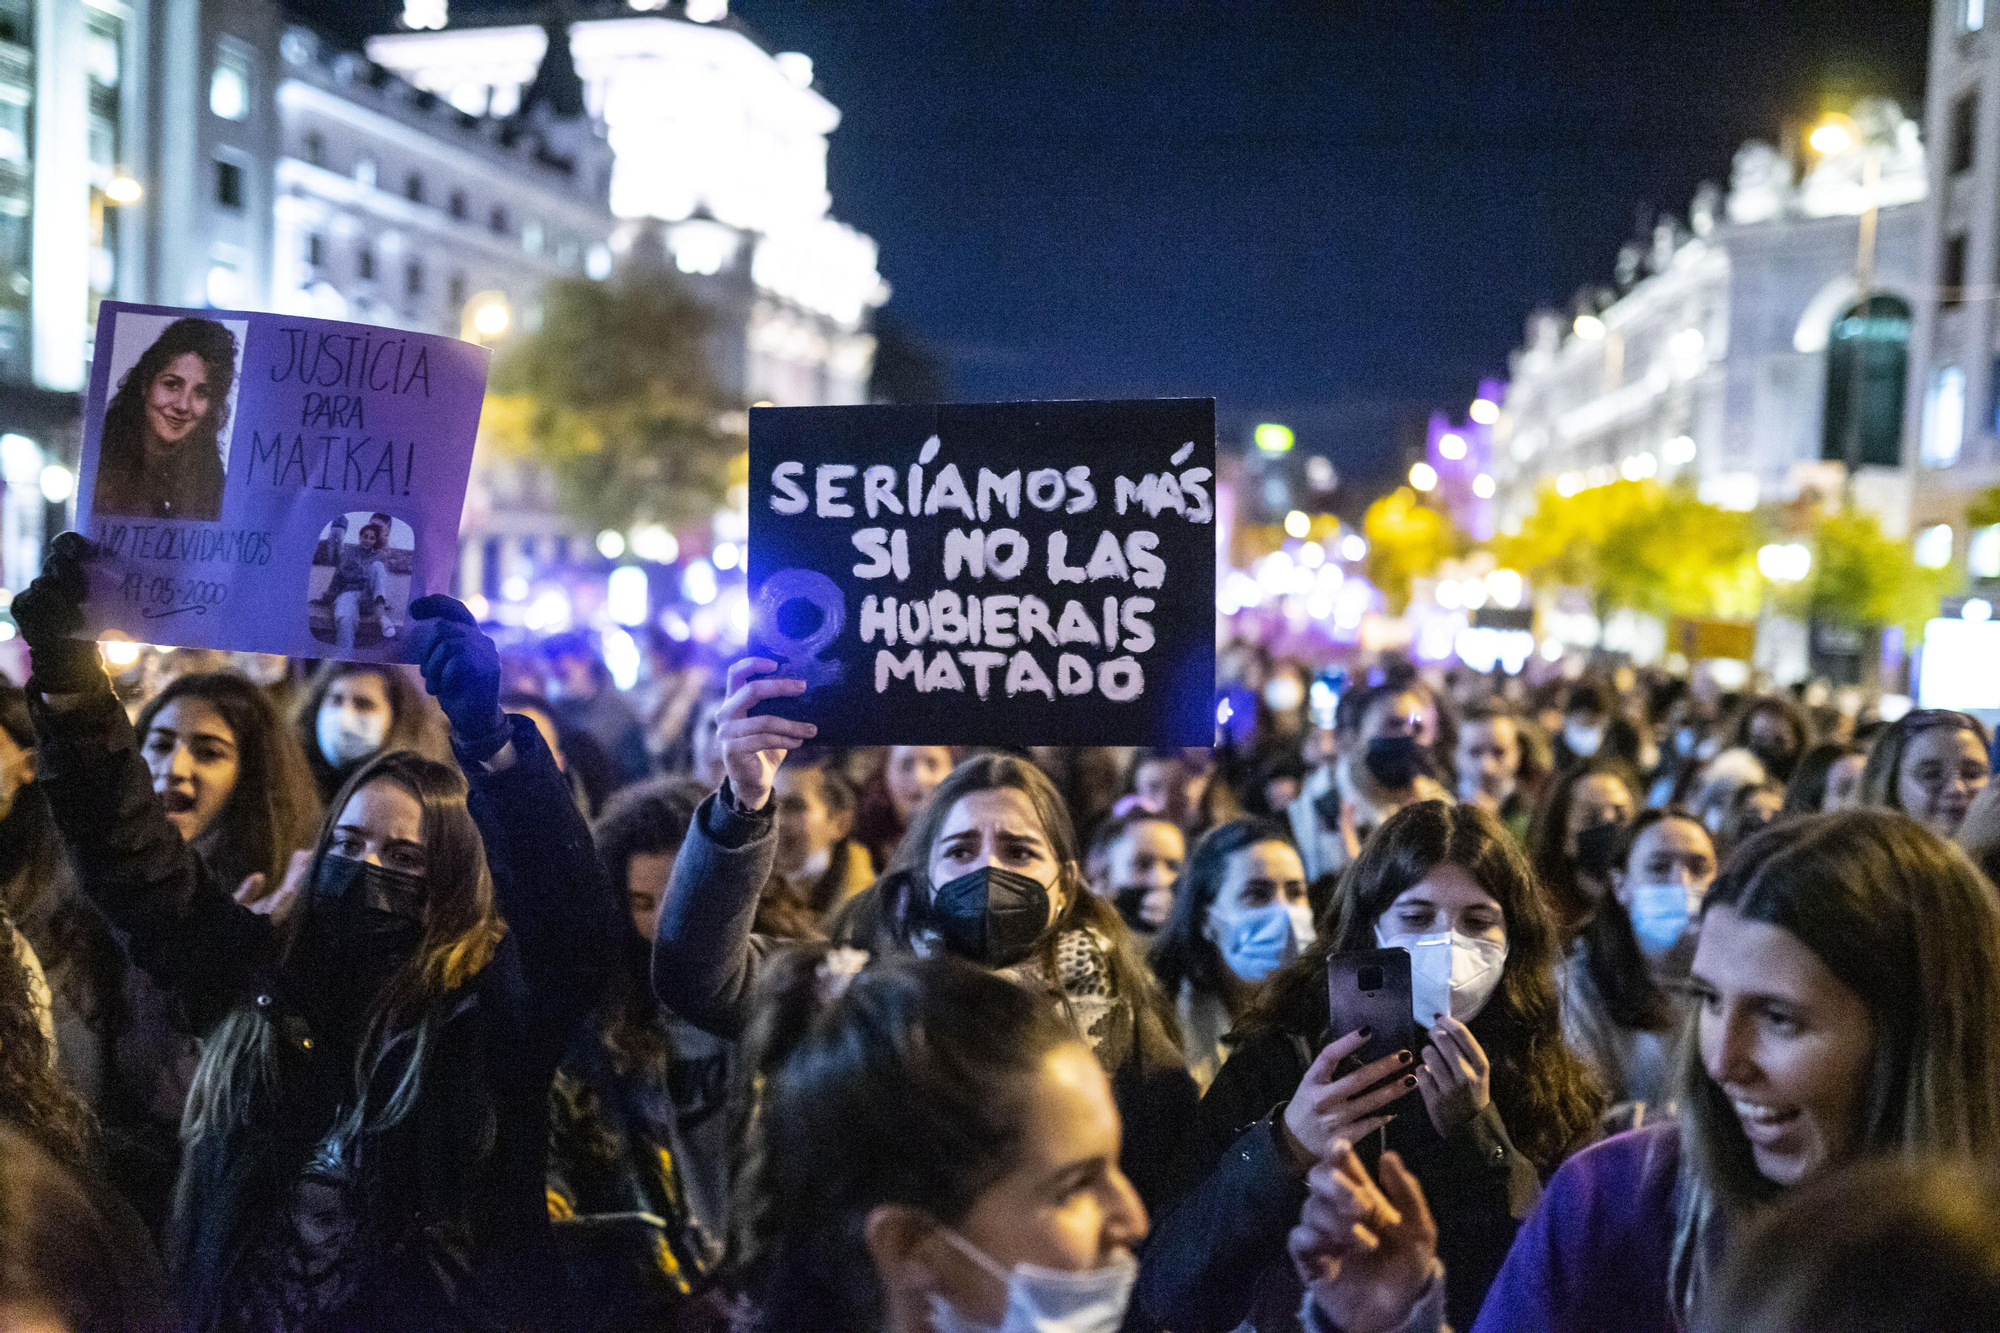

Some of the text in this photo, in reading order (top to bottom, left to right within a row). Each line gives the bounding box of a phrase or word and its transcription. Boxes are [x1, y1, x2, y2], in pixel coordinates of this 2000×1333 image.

[301, 391, 364, 429] PARA
[246, 430, 415, 498] MAIKA!
[769, 434, 1214, 524] SERÍAMOS MÁS
[851, 527, 1167, 589] SI NO LAS
[859, 589, 1157, 654] HUBIERAIS
[874, 648, 1145, 702] MATADO
